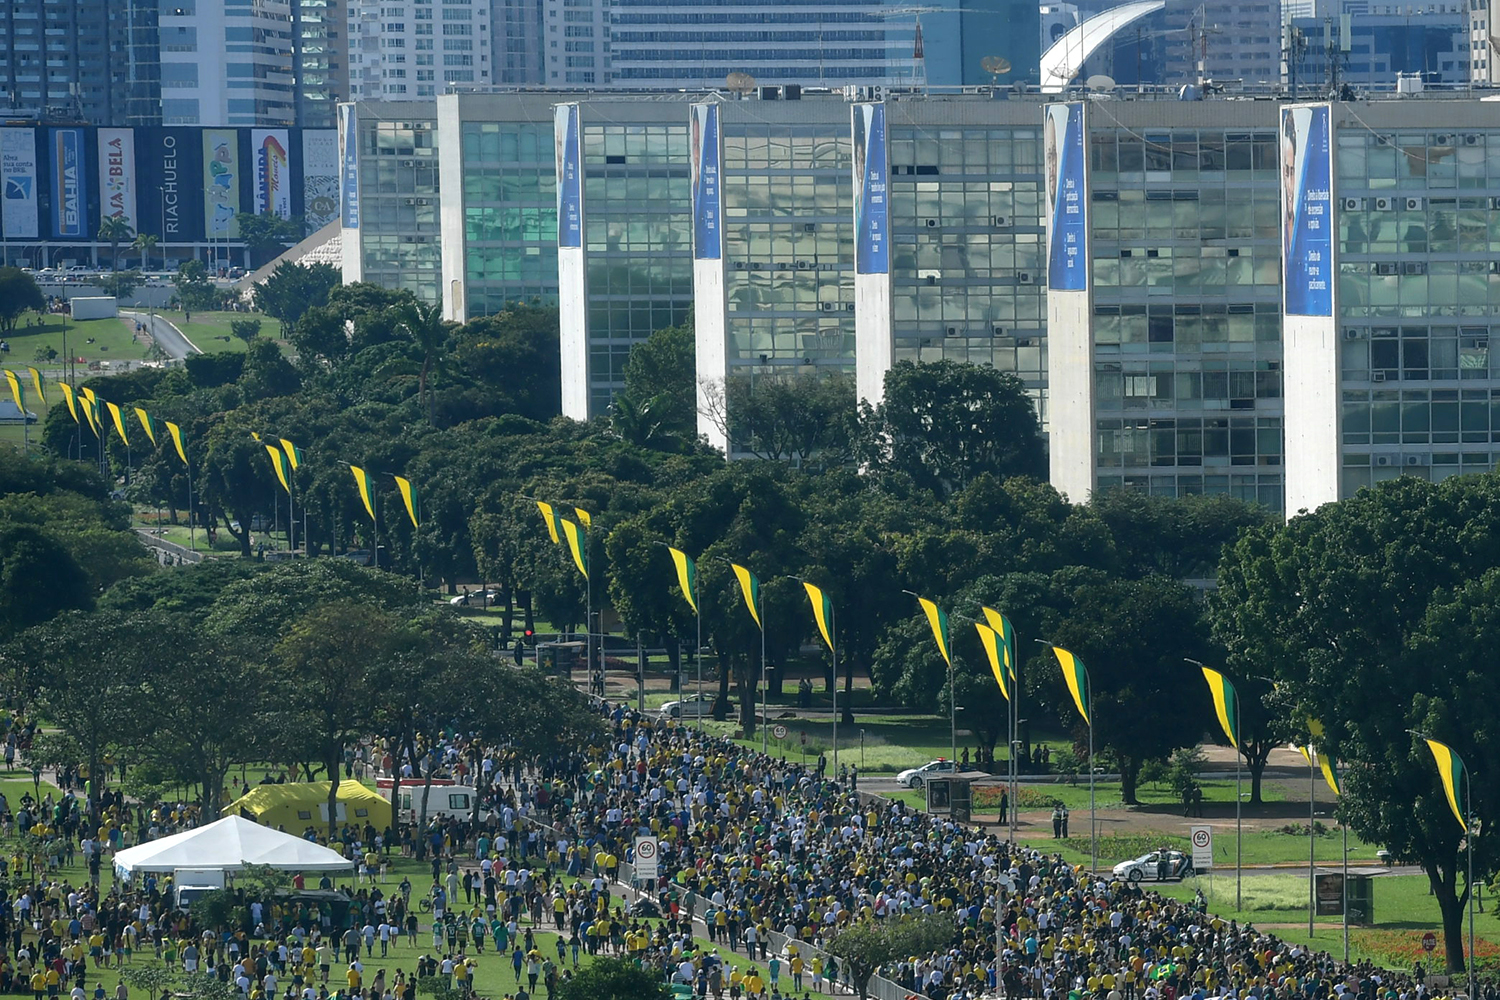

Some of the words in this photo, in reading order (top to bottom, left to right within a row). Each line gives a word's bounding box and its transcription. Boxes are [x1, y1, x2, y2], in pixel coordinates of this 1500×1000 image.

[108, 138, 123, 176] BELA
[64, 166, 77, 225] BAHIA
[163, 136, 179, 233] RIACHUELO
[1197, 833, 1206, 841] 60
